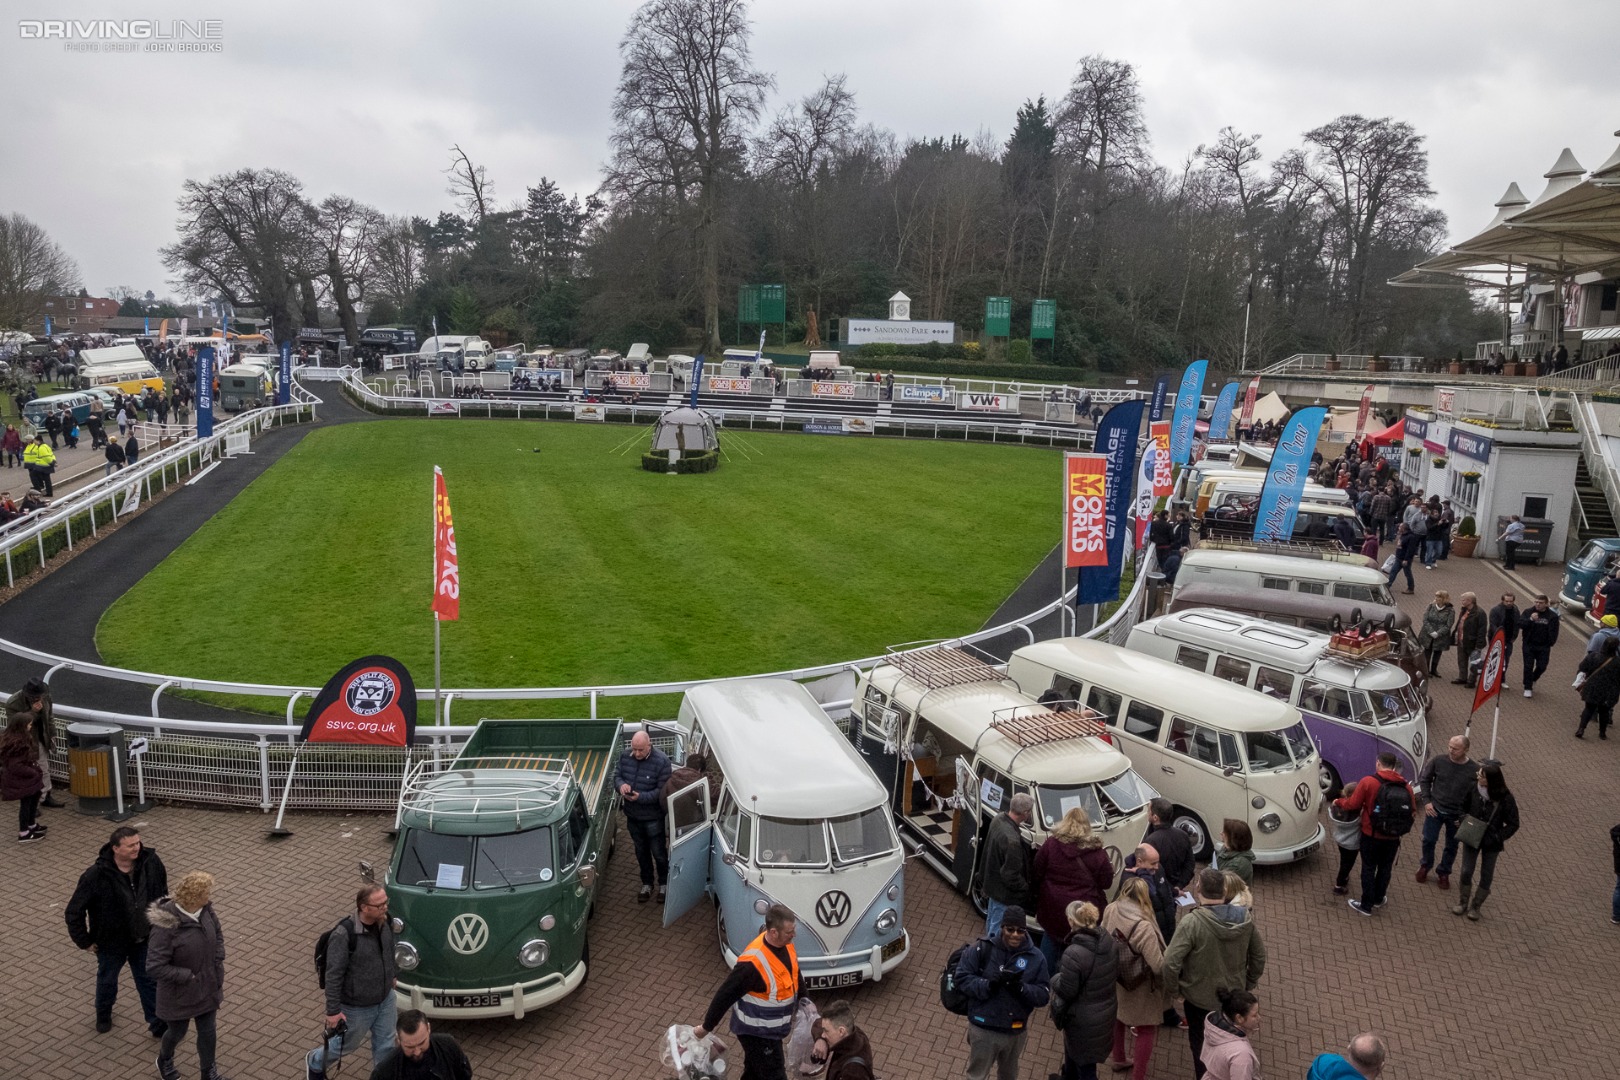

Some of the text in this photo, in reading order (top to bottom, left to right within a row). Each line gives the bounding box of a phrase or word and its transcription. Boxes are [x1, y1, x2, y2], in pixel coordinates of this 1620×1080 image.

[874, 326, 910, 334] SANDOWN
[1182, 368, 1199, 390] Crew
[1154, 382, 1163, 409] HERITAGE
[1178, 395, 1194, 409] Bus
[1116, 428, 1128, 472] CENTRE
[1282, 423, 1309, 456] Crew
[1273, 464, 1298, 486] Bus
[1072, 476, 1088, 553] WORLD
[1086, 474, 1104, 552] VOLKS
[350, 677, 360, 689] THE
[353, 705, 381, 715] VAN CLUB
[326, 720, 396, 733] ssvc.org.uk
[816, 890, 851, 927] VW
[448, 913, 489, 955] VW
[810, 972, 858, 988] LCV 119E
[434, 993, 500, 1007] NAL 233E
